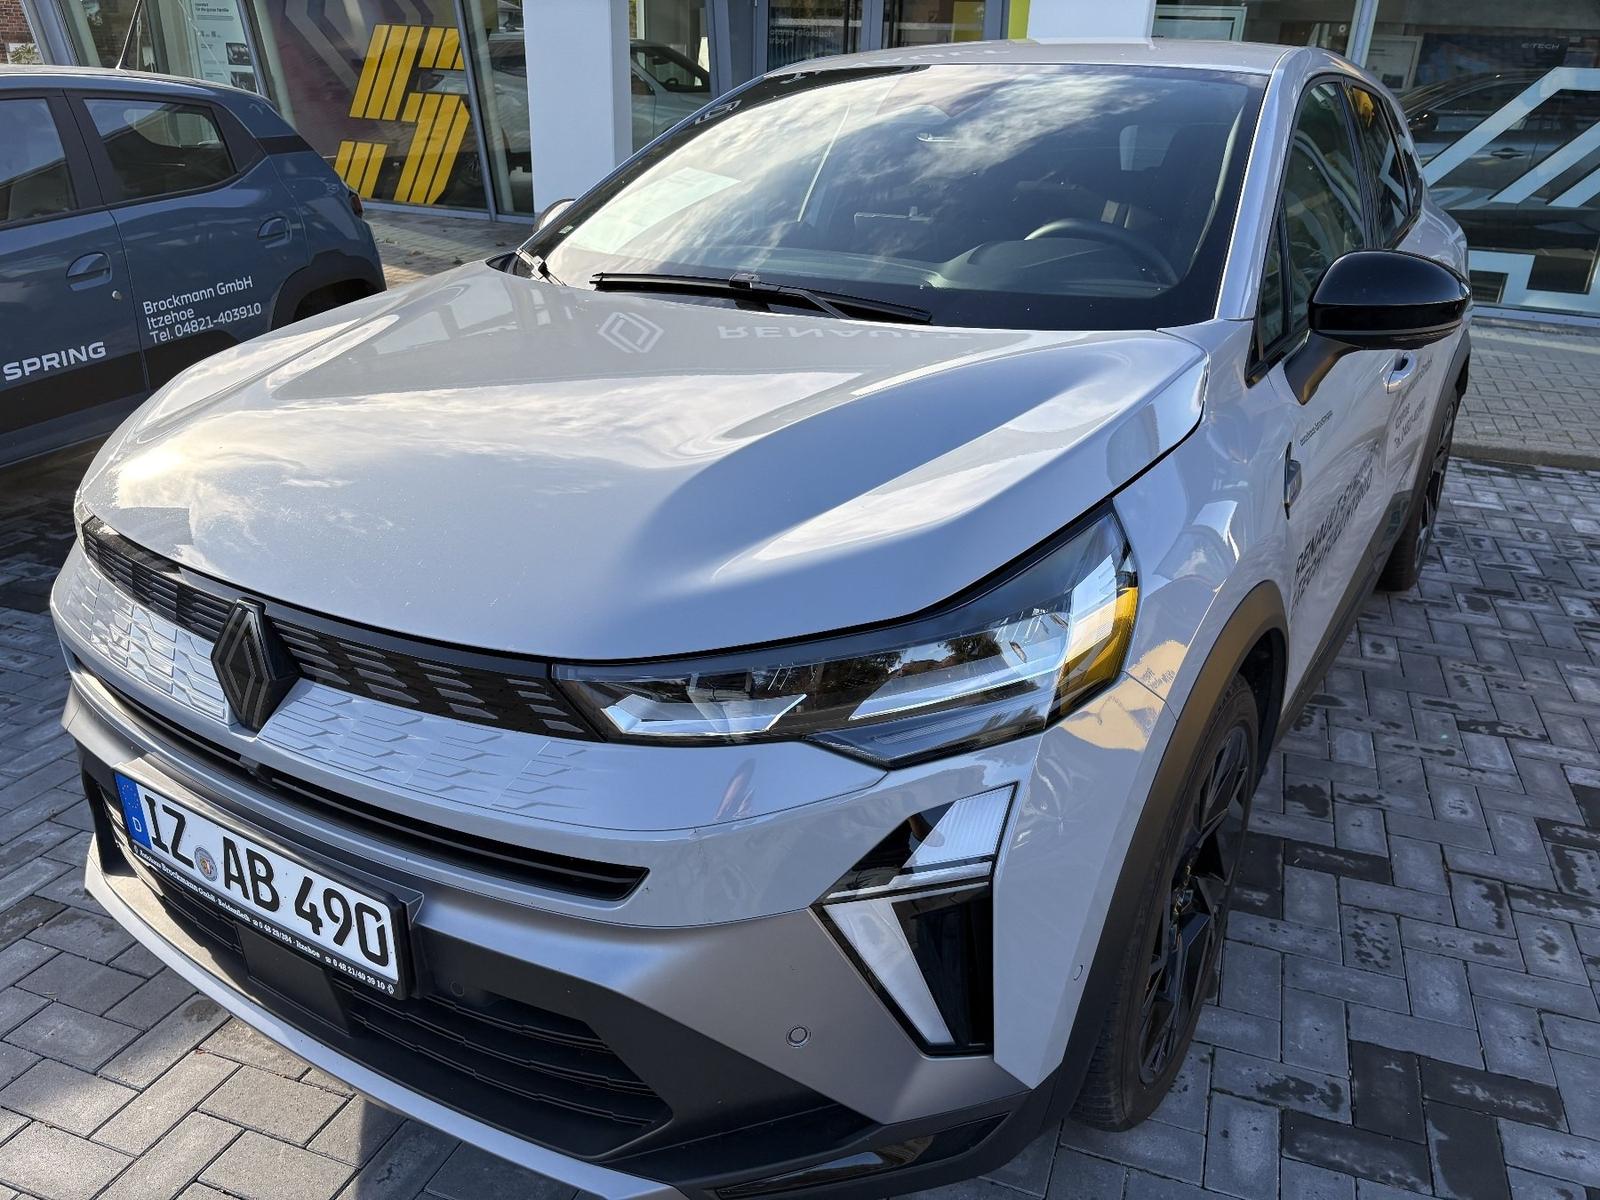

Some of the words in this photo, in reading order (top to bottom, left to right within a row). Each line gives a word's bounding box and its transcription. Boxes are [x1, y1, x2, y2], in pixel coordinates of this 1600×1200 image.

[142, 287, 215, 315] Brockmann
[216, 275, 253, 295] GmbH
[146, 308, 195, 330] Itzehoe
[149, 328, 174, 344] Tel.
[174, 302, 262, 337] 04821-403910
[3, 341, 107, 381] SPRING
[132, 816, 143, 832] D
[144, 794, 195, 870] IZ
[223, 836, 280, 913] AB
[294, 875, 389, 968] 490
[296, 939, 321, 958] Itzehoe
[376, 979, 386, 990] 10
